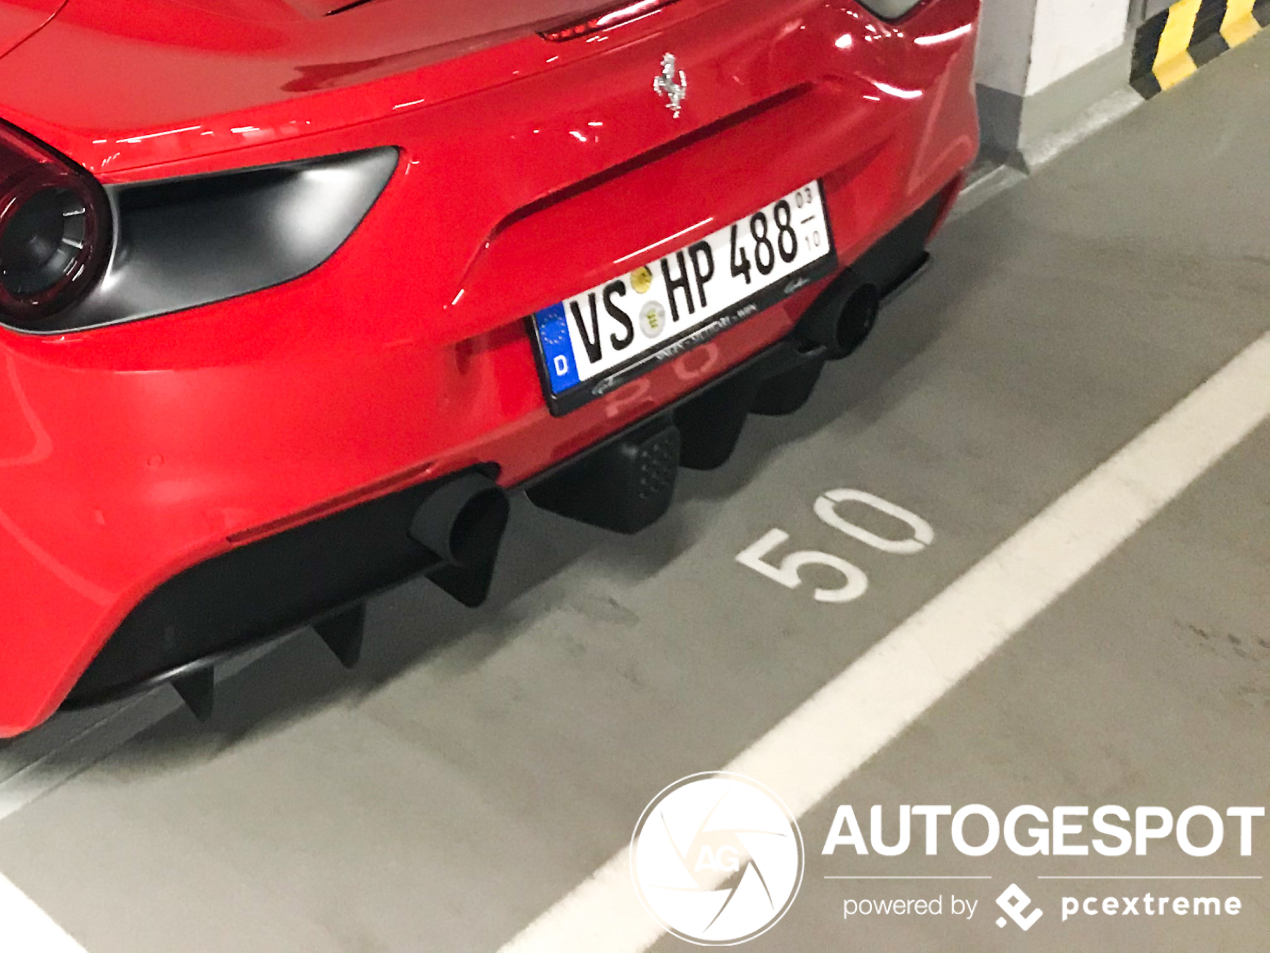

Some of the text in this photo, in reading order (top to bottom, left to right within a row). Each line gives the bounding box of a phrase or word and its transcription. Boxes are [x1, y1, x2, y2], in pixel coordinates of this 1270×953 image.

[569, 279, 634, 363] VS
[660, 241, 716, 323] HP
[730, 199, 798, 285] 488
[553, 354, 569, 377] D
[735, 488, 935, 603] 50
